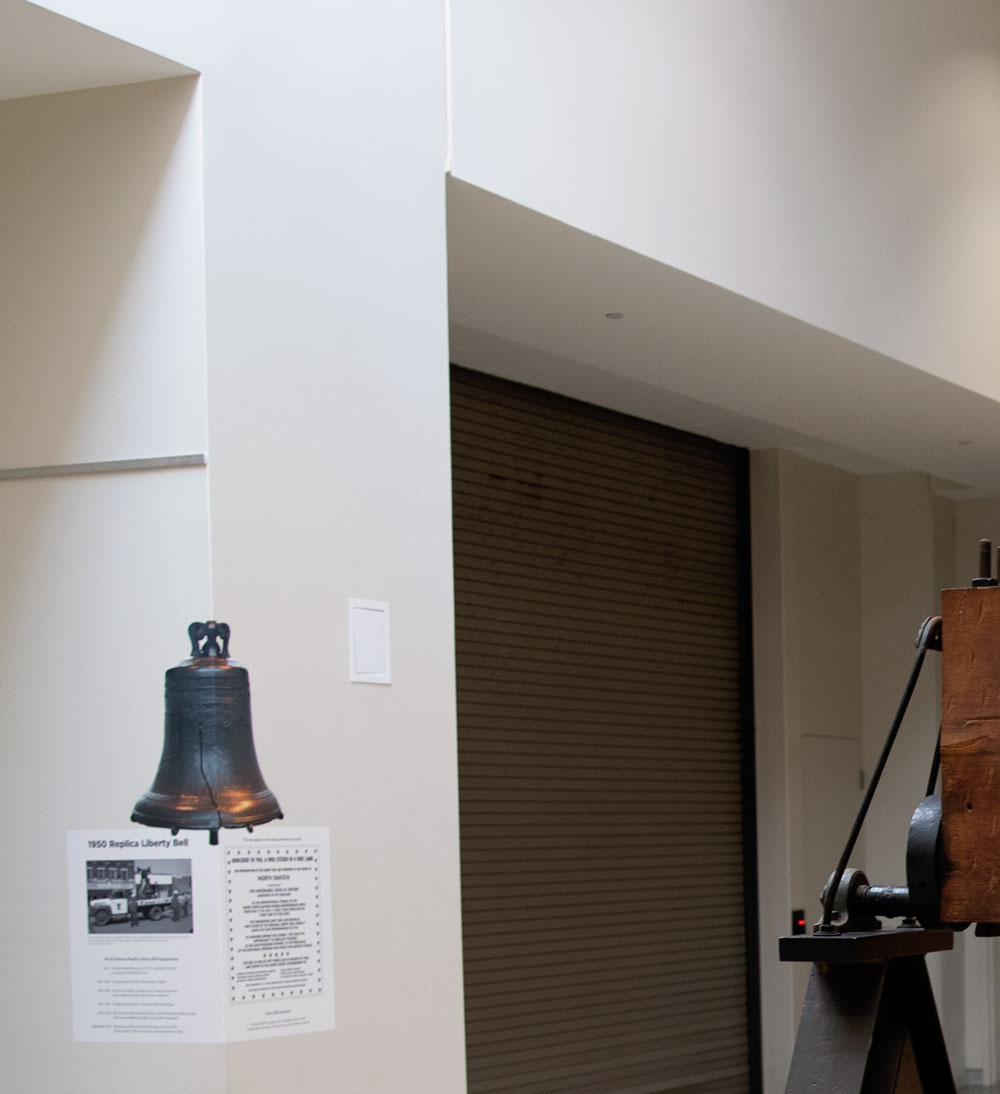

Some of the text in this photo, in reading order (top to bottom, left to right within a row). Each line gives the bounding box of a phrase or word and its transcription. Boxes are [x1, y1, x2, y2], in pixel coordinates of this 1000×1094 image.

[87, 838, 189, 850] 1950 Replica Liberty Bell
